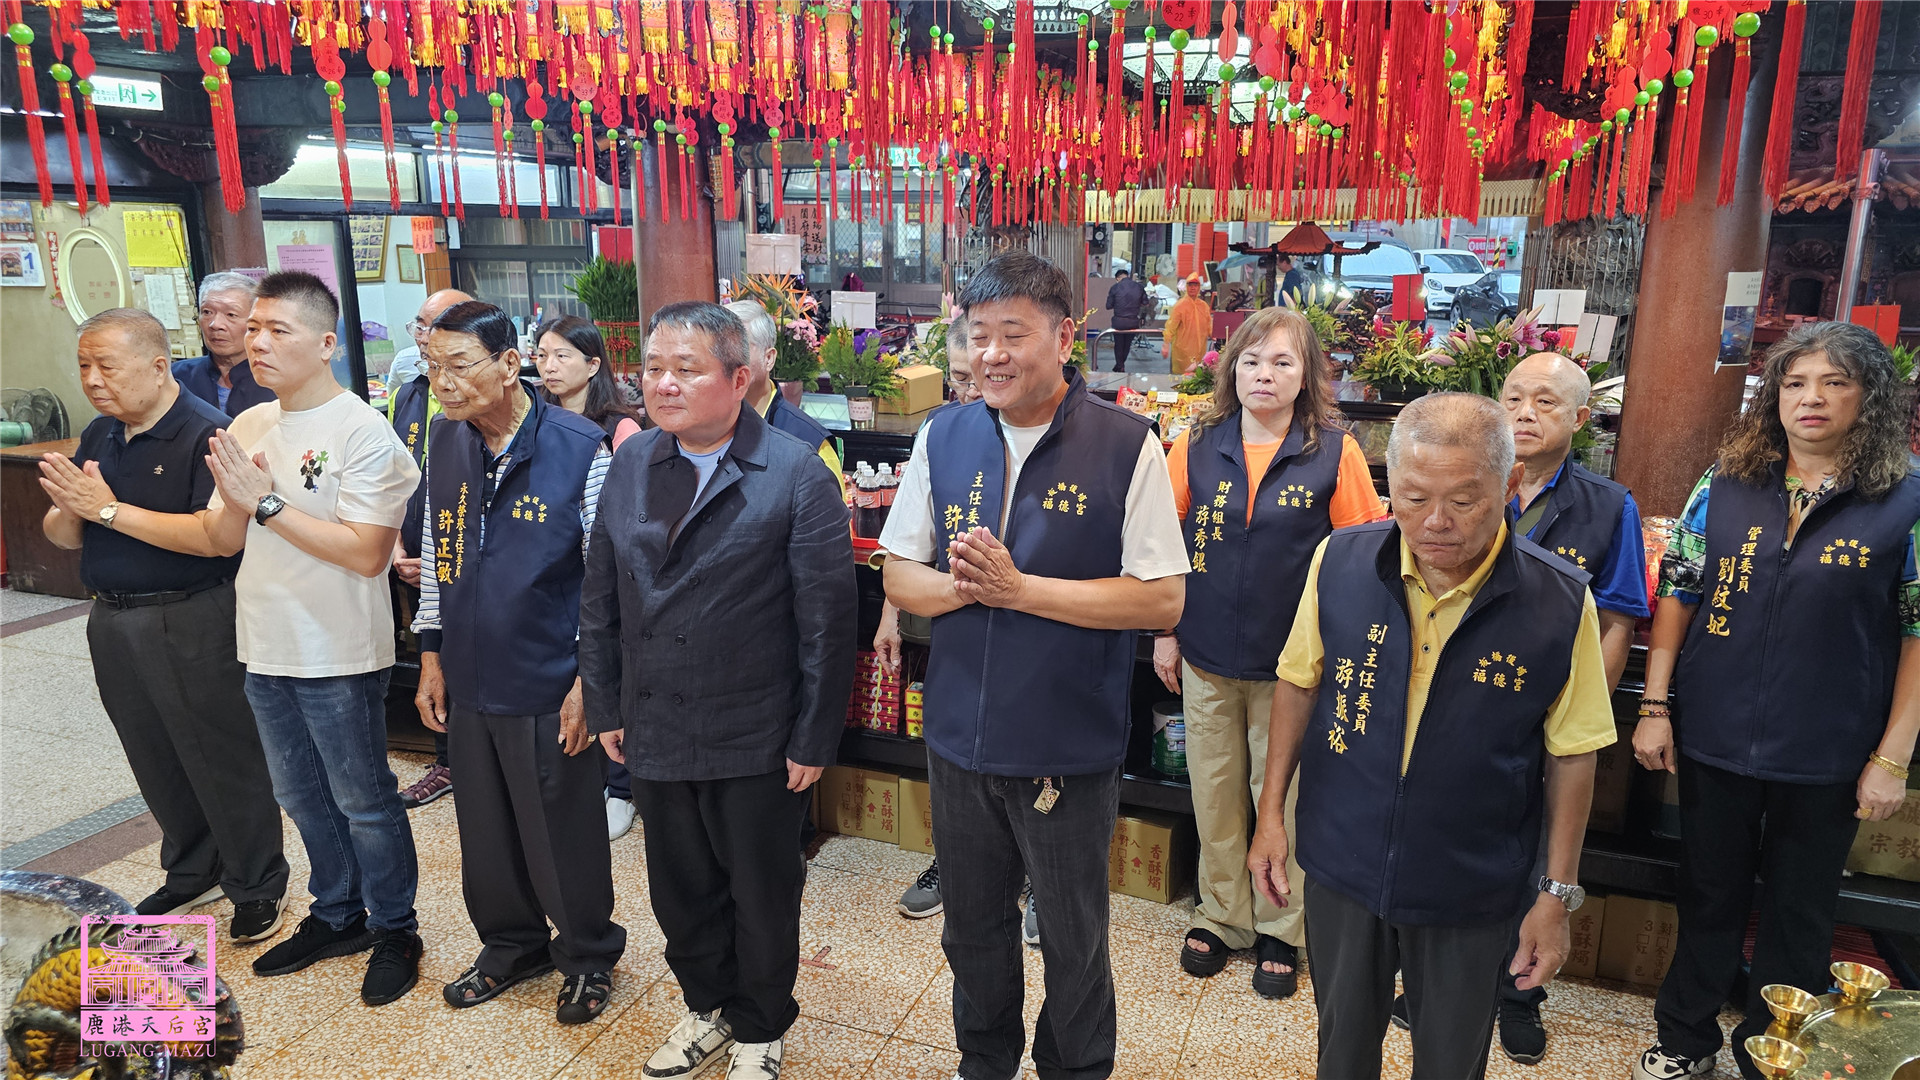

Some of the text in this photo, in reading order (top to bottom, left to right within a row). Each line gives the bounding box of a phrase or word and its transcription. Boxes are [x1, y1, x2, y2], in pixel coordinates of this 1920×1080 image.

[511, 507, 548, 523] 福德宮
[1042, 498, 1087, 516] 福德宮
[1211, 481, 1233, 541] 財務組長
[1278, 496, 1314, 509] 福德宮
[436, 508, 455, 585] 許正敏
[1192, 504, 1210, 573] 游秀銀
[1736, 526, 1763, 593] 管理委員
[1819, 553, 1870, 568] 福德宮
[1706, 555, 1737, 637] 劉紋妃
[1328, 657, 1356, 754] 游振裕
[1352, 623, 1389, 735] 副主任委員
[1472, 668, 1525, 692] 福德宮
